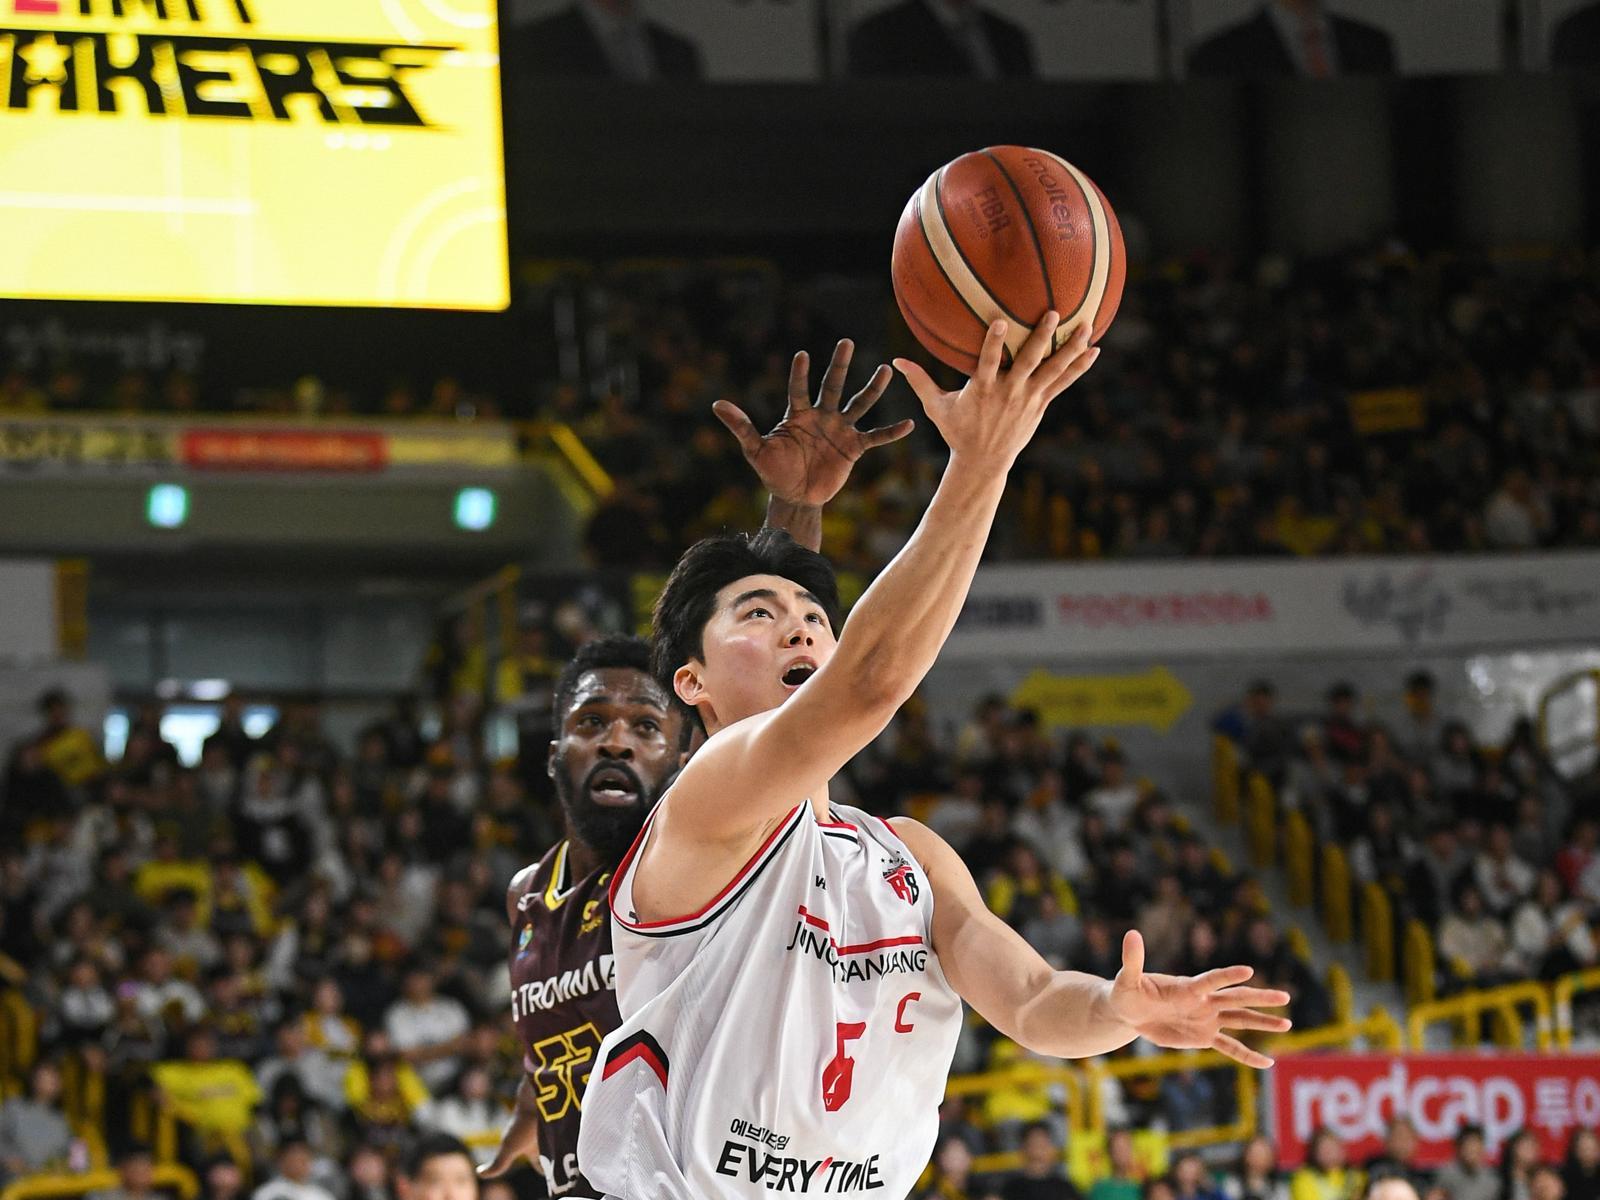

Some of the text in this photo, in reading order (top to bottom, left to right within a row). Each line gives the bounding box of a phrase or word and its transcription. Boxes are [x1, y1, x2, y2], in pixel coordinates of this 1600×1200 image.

[974, 185, 1011, 235] FIBA
[1023, 157, 1075, 240] molten
[519, 960, 600, 1017] TROMM
[894, 992, 922, 1034] C
[1291, 1060, 1525, 1157] redcap
